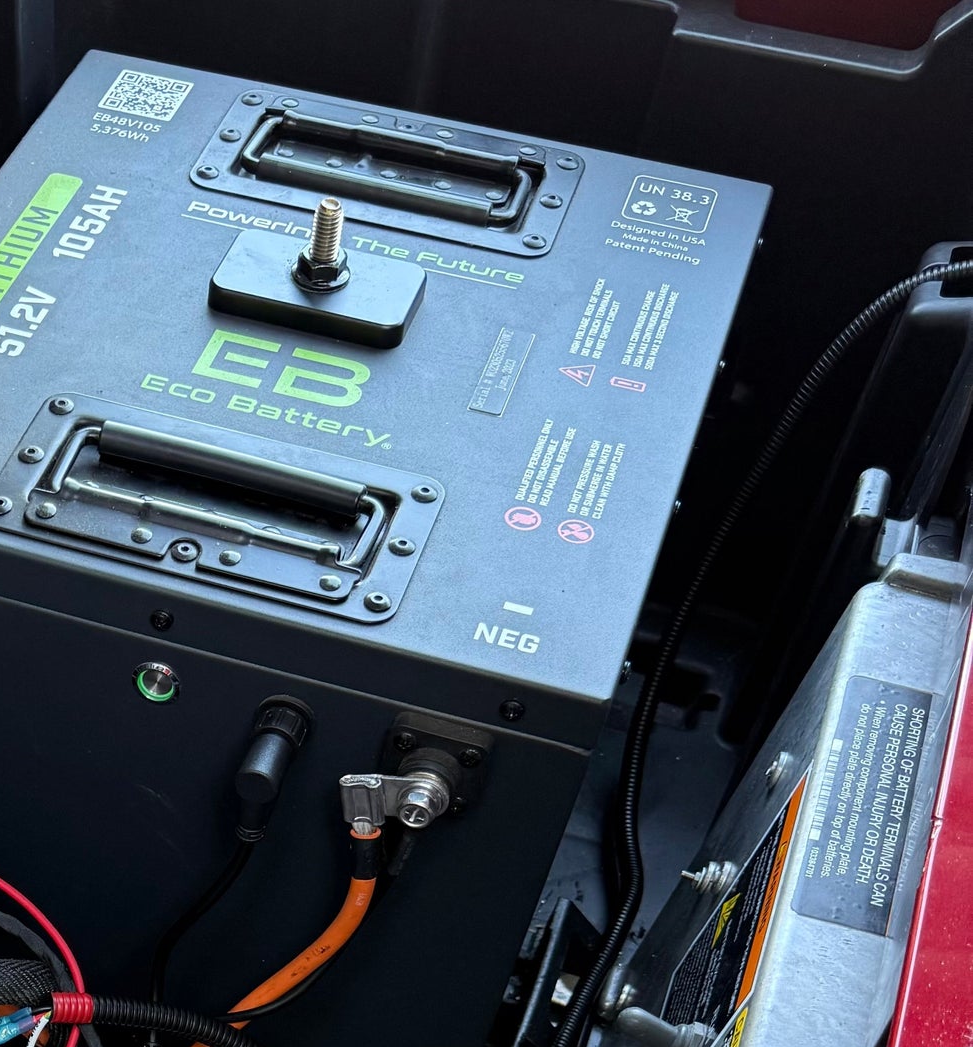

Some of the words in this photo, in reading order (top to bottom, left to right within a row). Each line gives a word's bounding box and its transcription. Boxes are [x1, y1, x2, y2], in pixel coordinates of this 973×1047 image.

[90, 123, 150, 143] 5,376Wh
[92, 112, 162, 134] EB48V105
[639, 182, 666, 196] UN
[670, 189, 710, 205] 38.3
[53, 184, 128, 260] 105AH
[611, 220, 666, 238] Designed
[682, 234, 706, 246] USA
[187, 200, 314, 240] Powerin
[352, 236, 410, 258] The
[416, 251, 525, 284] Future
[605, 238, 646, 253] Patent
[648, 248, 701, 266] Pending
[623, 233, 649, 244] Made
[651, 238, 659, 246] in
[661, 241, 689, 252] China
[589, 295, 599, 303] OF
[595, 289, 613, 319] TERMINALS
[588, 318, 601, 336] TOUCH
[629, 310, 648, 342] CONTINUOUS
[641, 310, 660, 343] CONTINUOUS
[580, 347, 590, 356] DO
[583, 336, 594, 348] NOT
[595, 338, 606, 350] NOT
[625, 341, 636, 354] MAX
[637, 342, 648, 354] MAX
[649, 343, 660, 356] MAX
[592, 350, 602, 359] DO
[191, 328, 371, 408] EB
[140, 373, 216, 404] Eco
[472, 385, 490, 408] Serial
[527, 433, 548, 468] PERSONNEL
[540, 418, 554, 434] ONLY
[563, 426, 576, 440] USE
[535, 438, 559, 481] DISASSEMBLE
[555, 438, 571, 463] BEFORE
[586, 439, 601, 458] WASH
[596, 442, 612, 465] WATER
[611, 442, 626, 463] CLOTH
[545, 462, 563, 489] MANUAL
[575, 457, 595, 490] PRESSURE
[594, 464, 605, 472] IN
[605, 462, 619, 481] DAMP
[526, 493, 538, 503] DO
[530, 480, 543, 493] NOT
[538, 488, 553, 506] READ
[570, 489, 583, 503] NOT
[582, 471, 602, 506] SUBMERGE
[599, 480, 613, 498] WITH
[567, 503, 578, 513] DO
[579, 506, 591, 516] OR
[591, 497, 607, 519] CLEAN
[473, 622, 541, 654] NEG
[859, 702, 871, 714] do
[871, 706, 885, 729] When
[889, 702, 908, 736] CAUSE
[856, 714, 868, 727] not
[902, 707, 925, 757] SHORTING
[849, 727, 865, 750] place
[860, 729, 880, 766] removing
[844, 750, 860, 771] plate
[876, 737, 900, 791] PERSONAL
[899, 758, 914, 774] OF
[837, 771, 855, 801] directly
[849, 765, 871, 812] component
[889, 774, 910, 820] BATTERY
[835, 801, 846, 814] on
[867, 791, 888, 829] INJURY
[830, 813, 845, 828] top
[839, 812, 860, 851] mounting
[829, 829, 841, 839] of
[863, 829, 879, 847] OR
[819, 839, 839, 879] batteries.
[875, 820, 900, 881] TERMINALS
[834, 852, 850, 877] plate,
[854, 847, 875, 886] DEATH.
[870, 881, 887, 907] CAN
